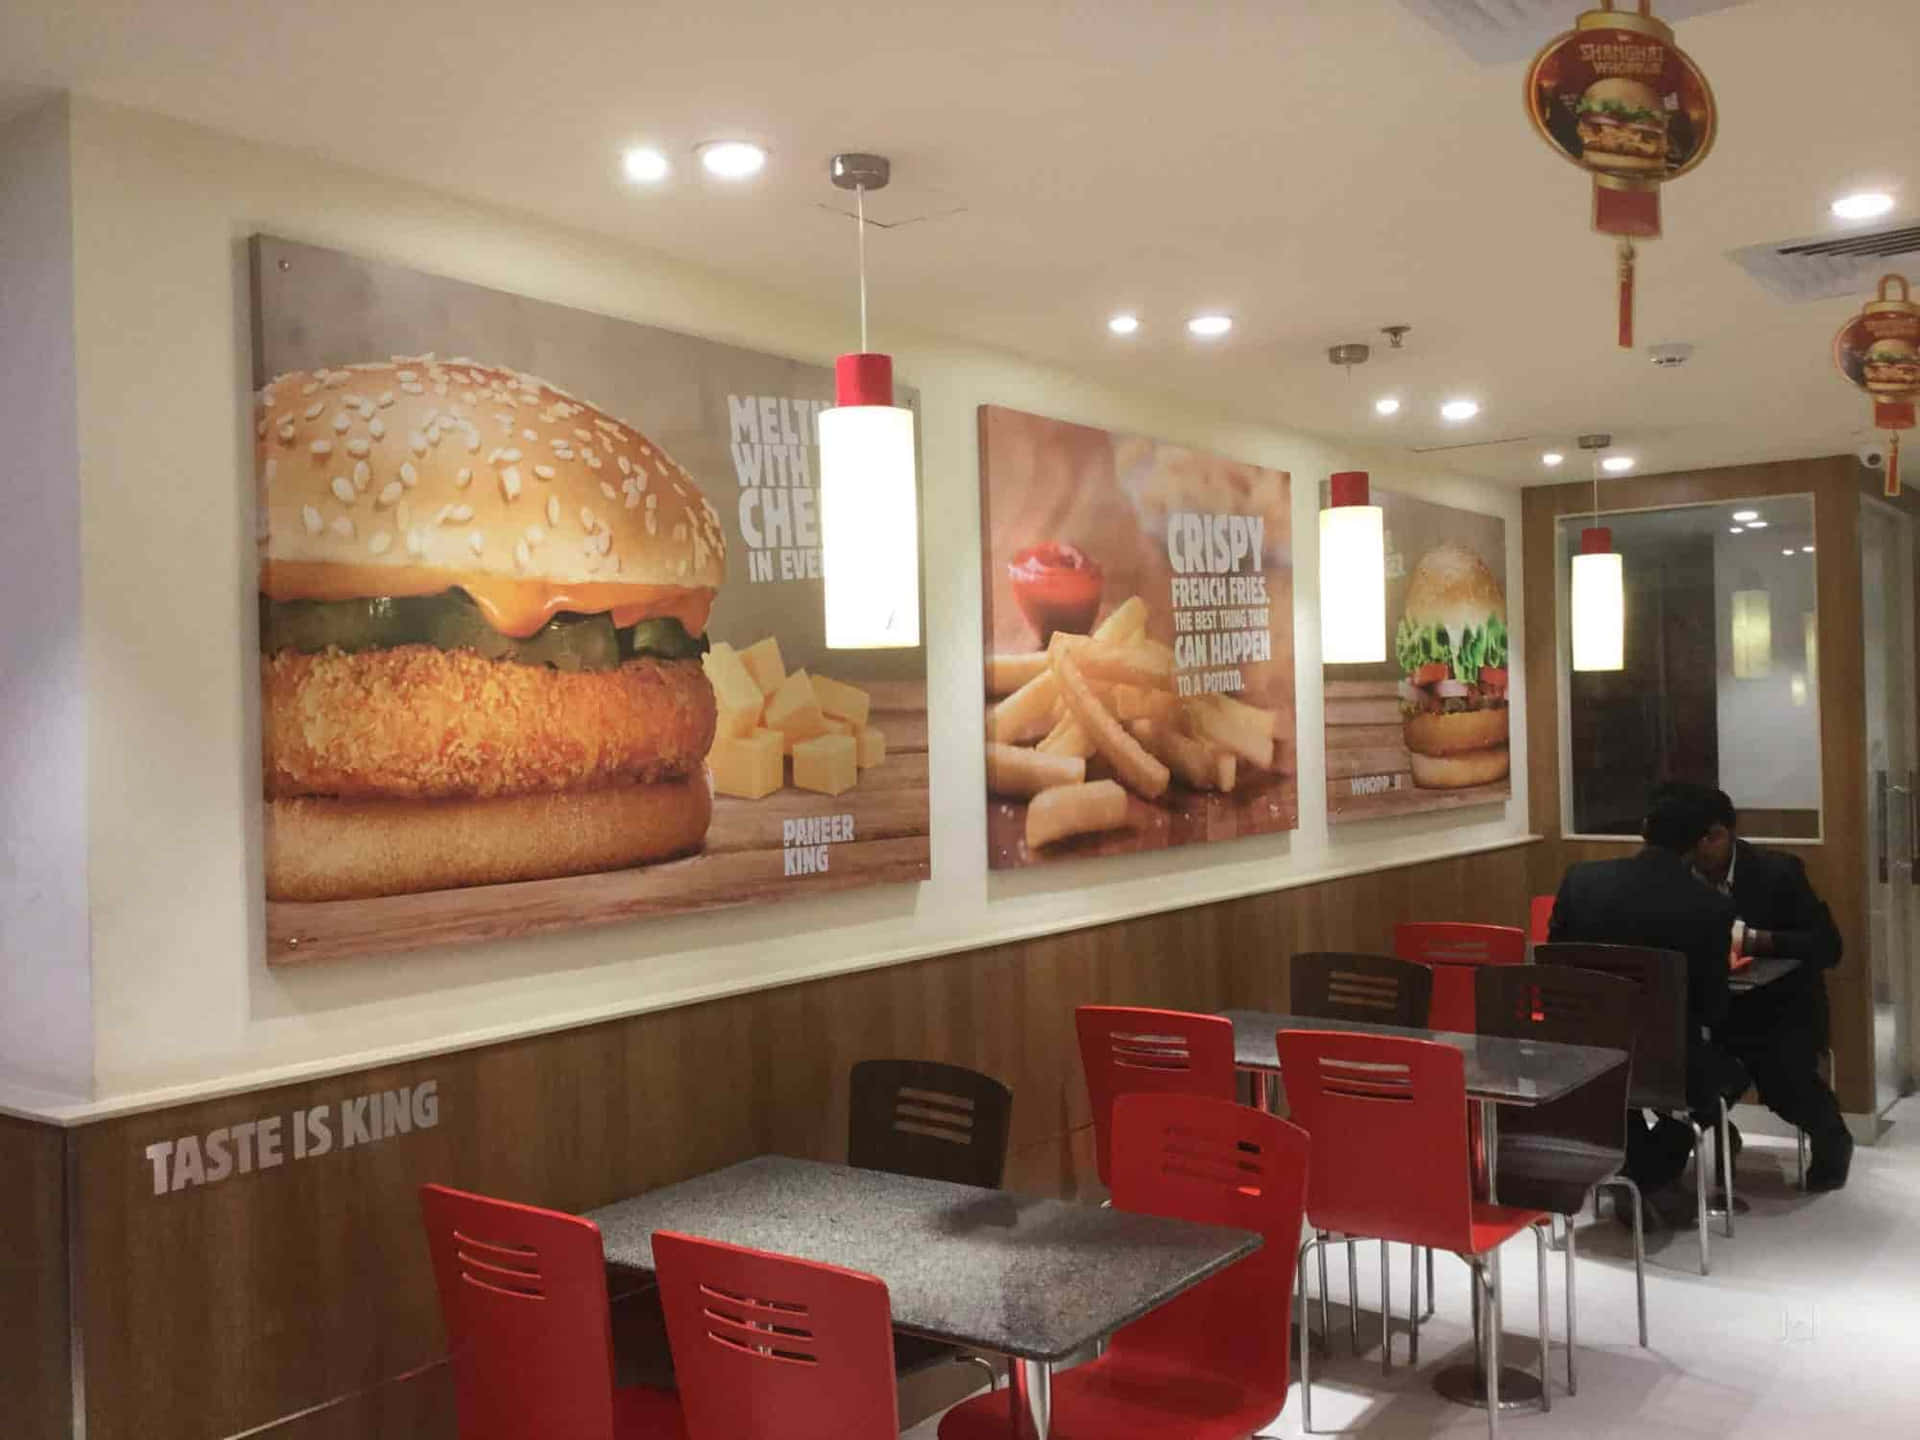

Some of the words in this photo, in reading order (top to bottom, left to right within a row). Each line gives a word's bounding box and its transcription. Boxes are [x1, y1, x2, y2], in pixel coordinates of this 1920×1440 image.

[731, 442, 810, 488] WITH
[739, 487, 822, 549] CHE
[1168, 513, 1264, 573] CRISPY
[749, 550, 773, 583] IN
[781, 549, 824, 580] EVE
[1171, 576, 1227, 607] FRENCH
[1174, 612, 1193, 631] THE
[1195, 610, 1217, 630] BEST
[1219, 609, 1247, 629] THING
[1175, 634, 1207, 668] CAN
[1210, 630, 1271, 666] HAPPEN
[1177, 675, 1191, 698] TO
[1194, 673, 1202, 696] A
[784, 814, 855, 847] PANEER
[784, 844, 829, 876] KING
[146, 1116, 283, 1195] TASTE
[293, 1105, 332, 1160] IS
[341, 1080, 439, 1148] KING
